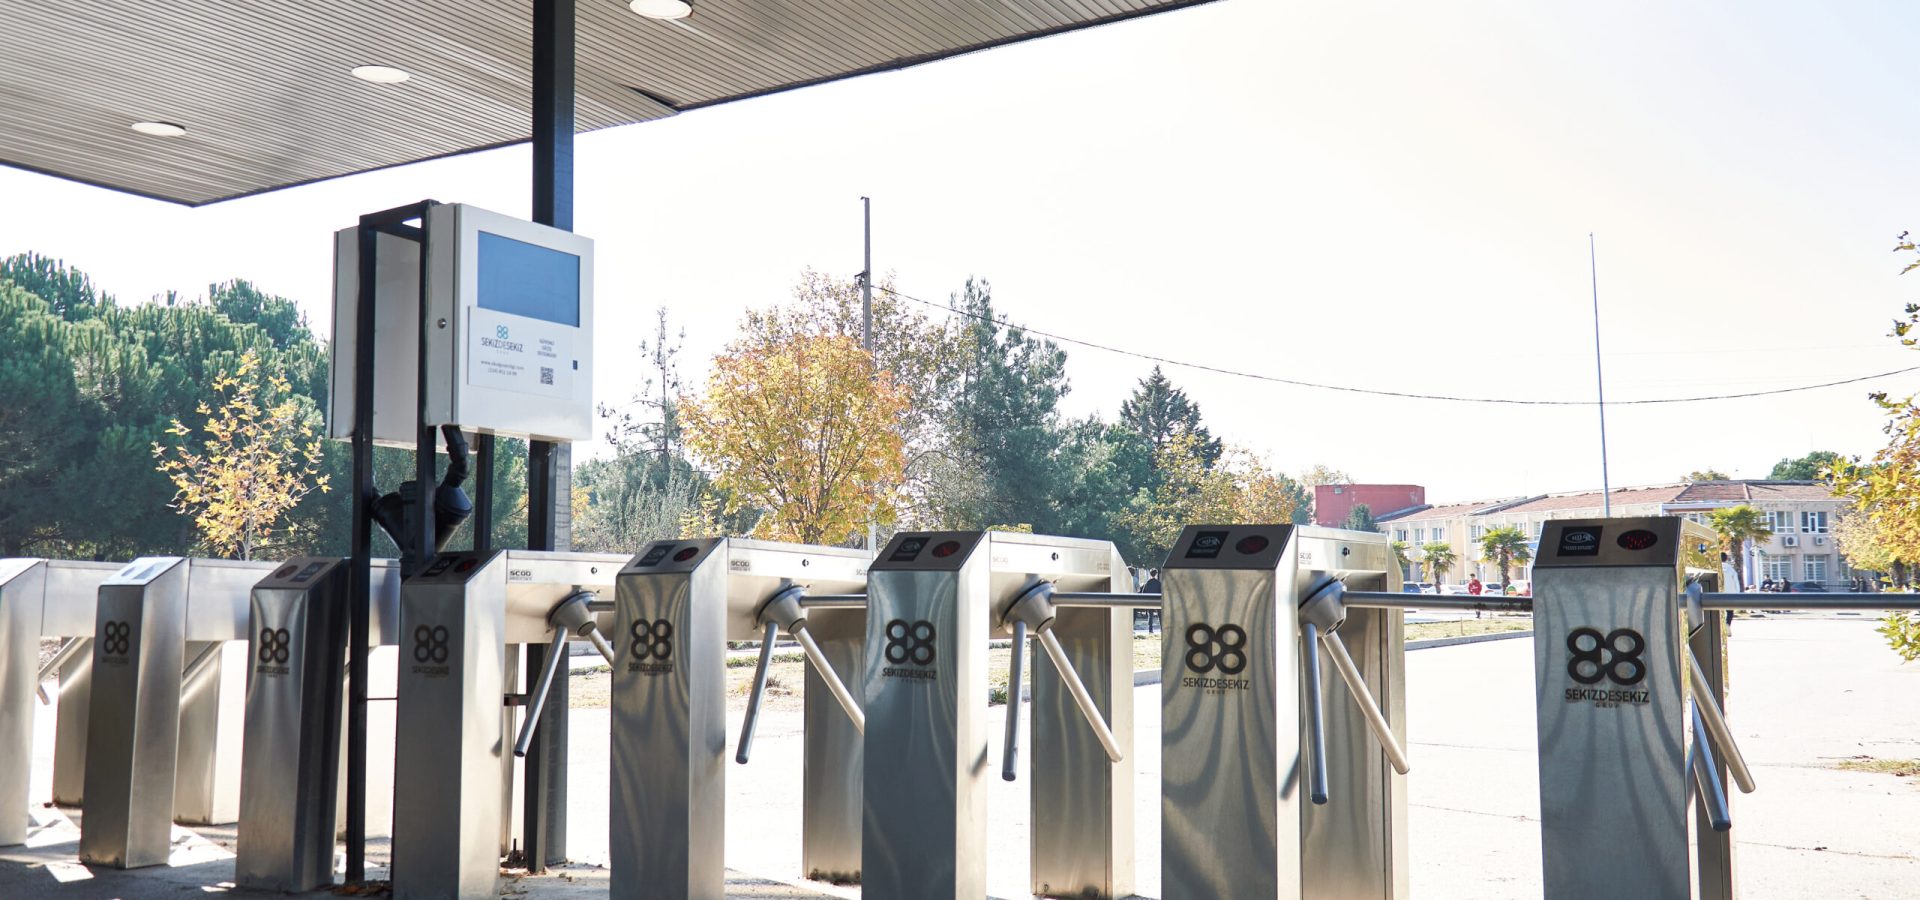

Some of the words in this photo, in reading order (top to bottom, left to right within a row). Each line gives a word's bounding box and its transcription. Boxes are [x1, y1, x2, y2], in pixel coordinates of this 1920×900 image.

[496, 325, 508, 339] 88
[104, 620, 130, 656] 88
[259, 627, 290, 664] 88
[414, 624, 449, 664] 88
[630, 618, 672, 661] 88
[885, 618, 936, 667] 88
[1184, 622, 1247, 675] 88
[1566, 627, 1646, 686] 88
